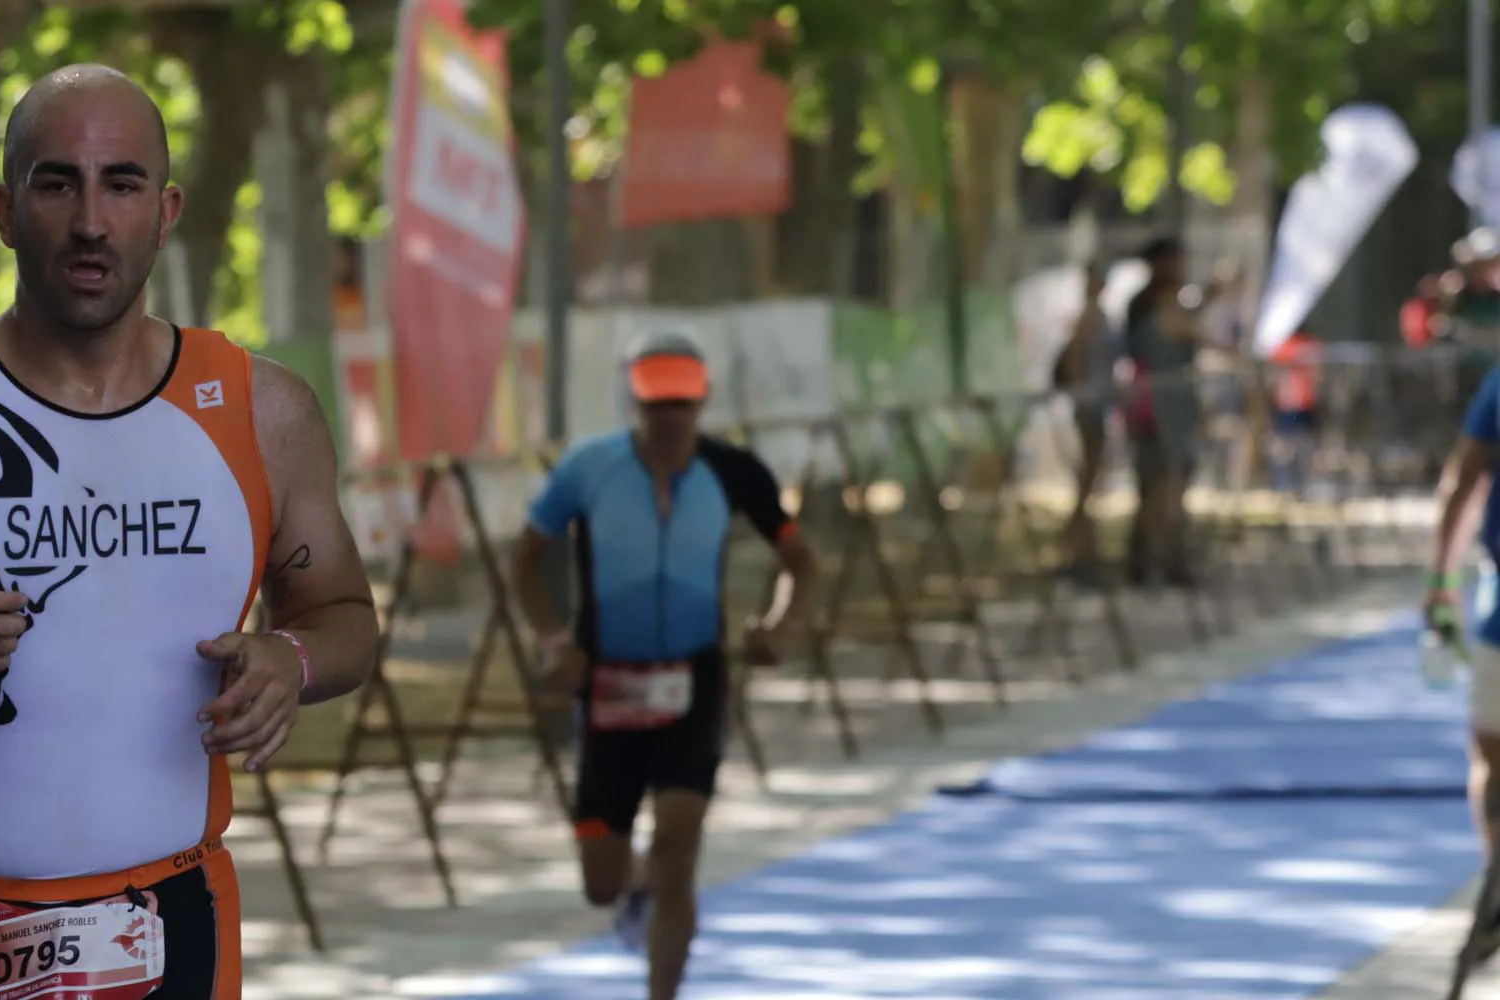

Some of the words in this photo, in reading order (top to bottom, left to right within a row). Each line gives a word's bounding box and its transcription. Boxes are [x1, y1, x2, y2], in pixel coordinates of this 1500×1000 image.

[4, 499, 206, 560] SANCHEZ
[174, 848, 203, 868] Club
[2, 928, 32, 943] MANUEL
[68, 916, 98, 927] ROBLES
